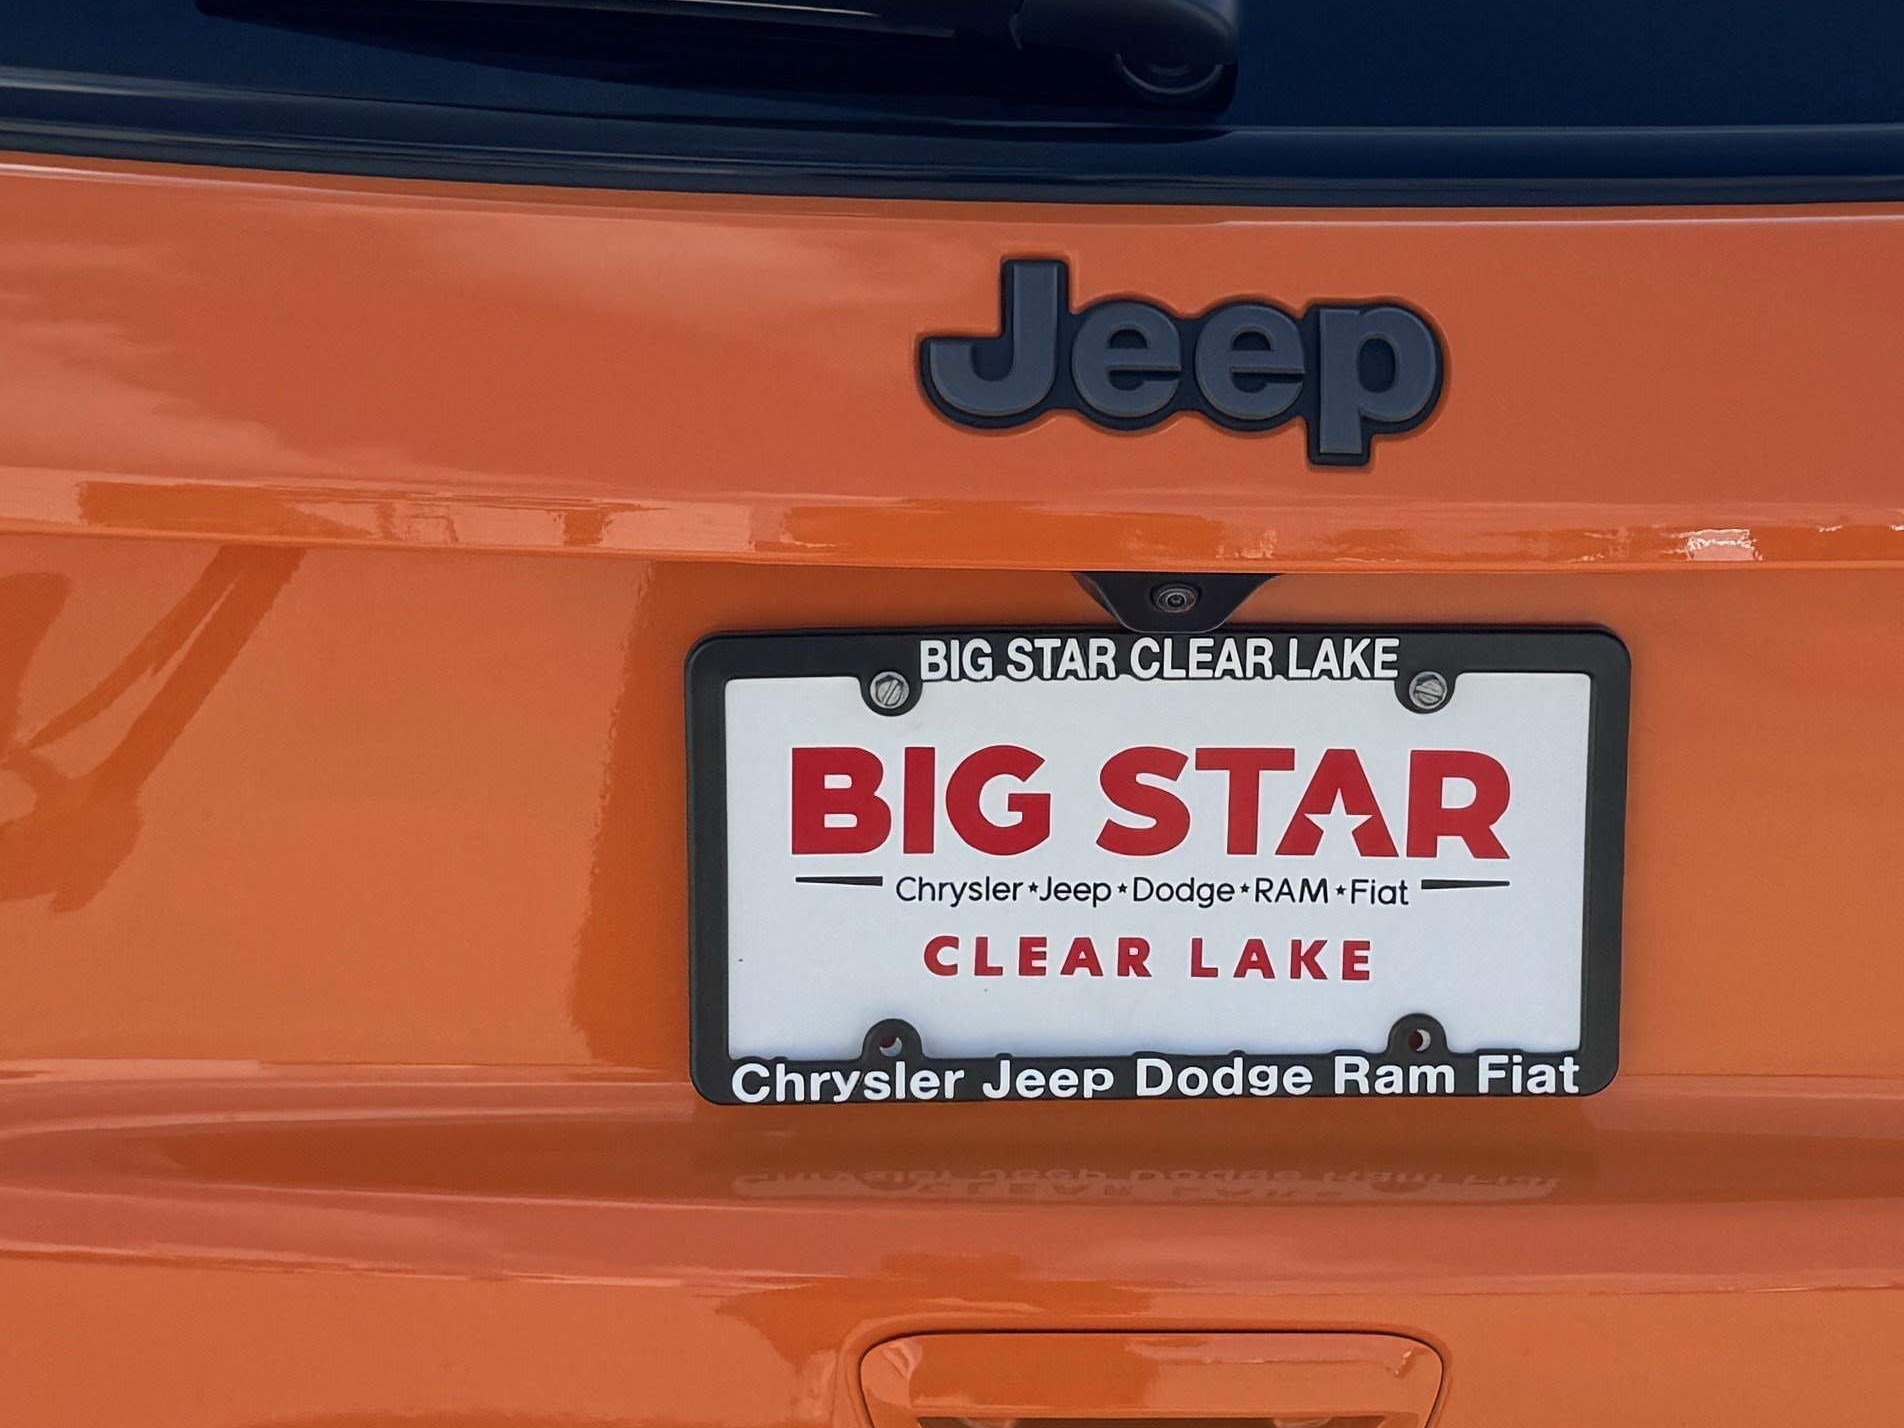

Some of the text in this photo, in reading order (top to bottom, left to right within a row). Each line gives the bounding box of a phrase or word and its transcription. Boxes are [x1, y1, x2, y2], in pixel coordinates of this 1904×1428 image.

[920, 259, 1444, 465] Jeep
[920, 637, 1401, 682] BIG STAR CLEAR LAKE
[791, 745, 1510, 859] BIG STAR
[924, 936, 1370, 980] CLEAR LAKE
[731, 1054, 1580, 1103] Chrysler Jeep Dodge Ram Fiat
